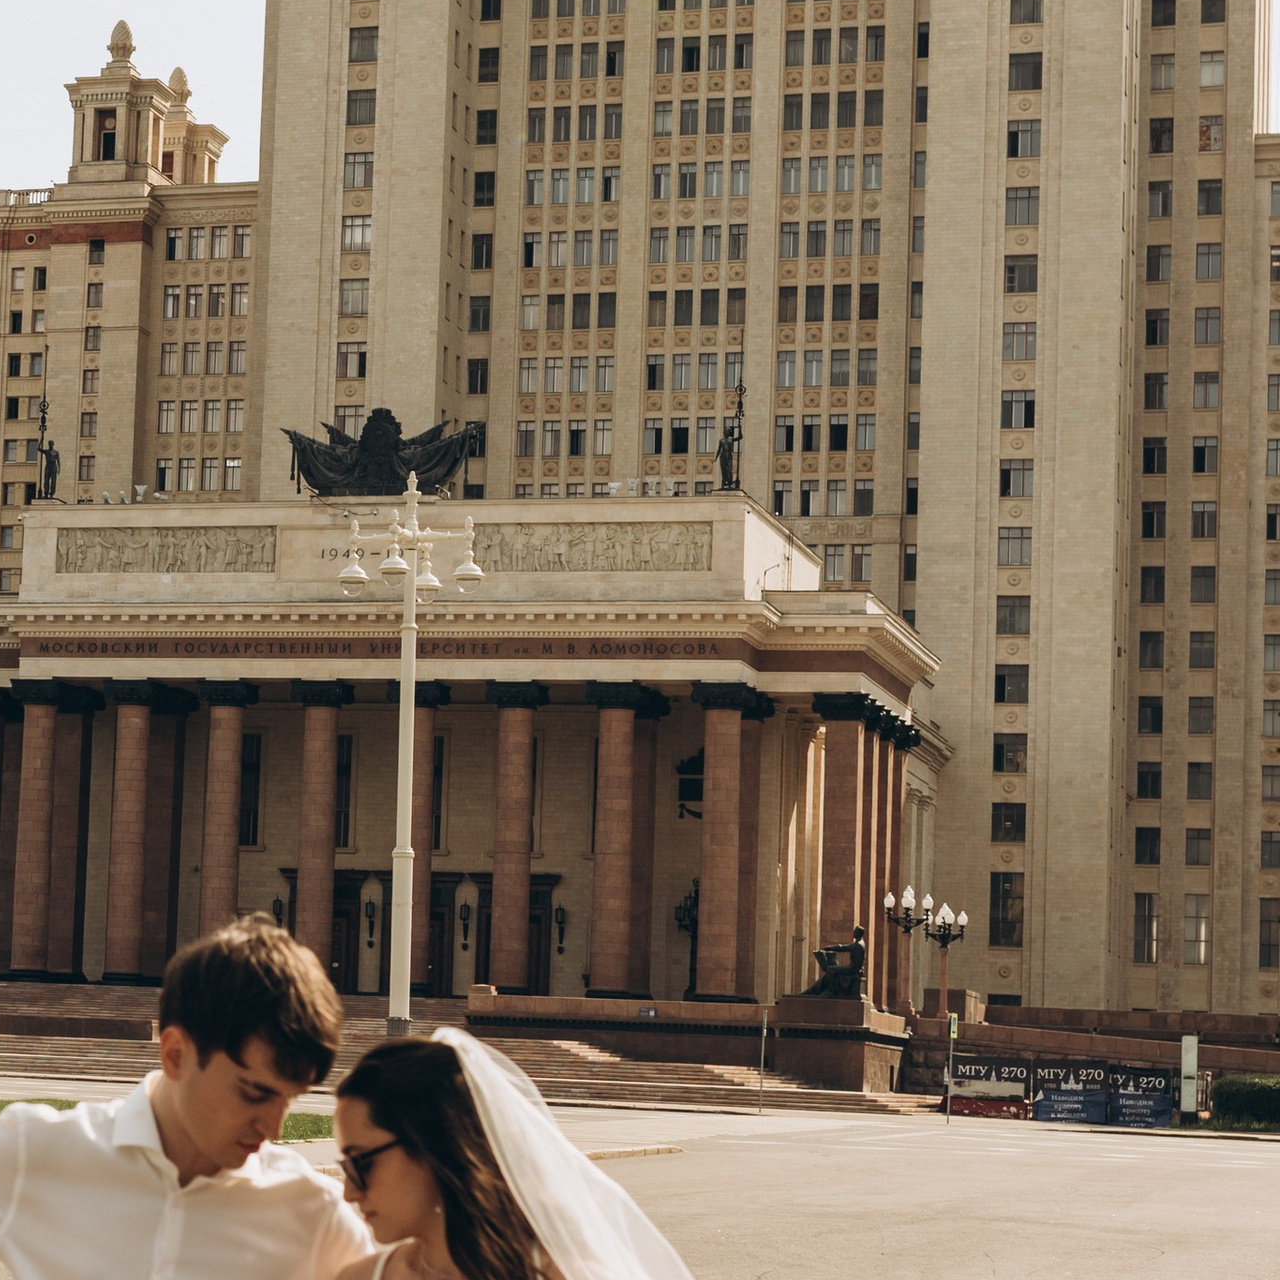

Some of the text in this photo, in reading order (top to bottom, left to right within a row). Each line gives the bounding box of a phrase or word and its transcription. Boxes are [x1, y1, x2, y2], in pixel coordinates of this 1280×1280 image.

[369, 642, 502, 655] УНИЕРСИТЕТ
[588, 643, 719, 655] ЛОМОНОСОВА
[957, 1064, 1027, 1079] МГУ 270
[1036, 1068, 1105, 1081] МГУ 270
[1139, 1076, 1165, 1089] 270
